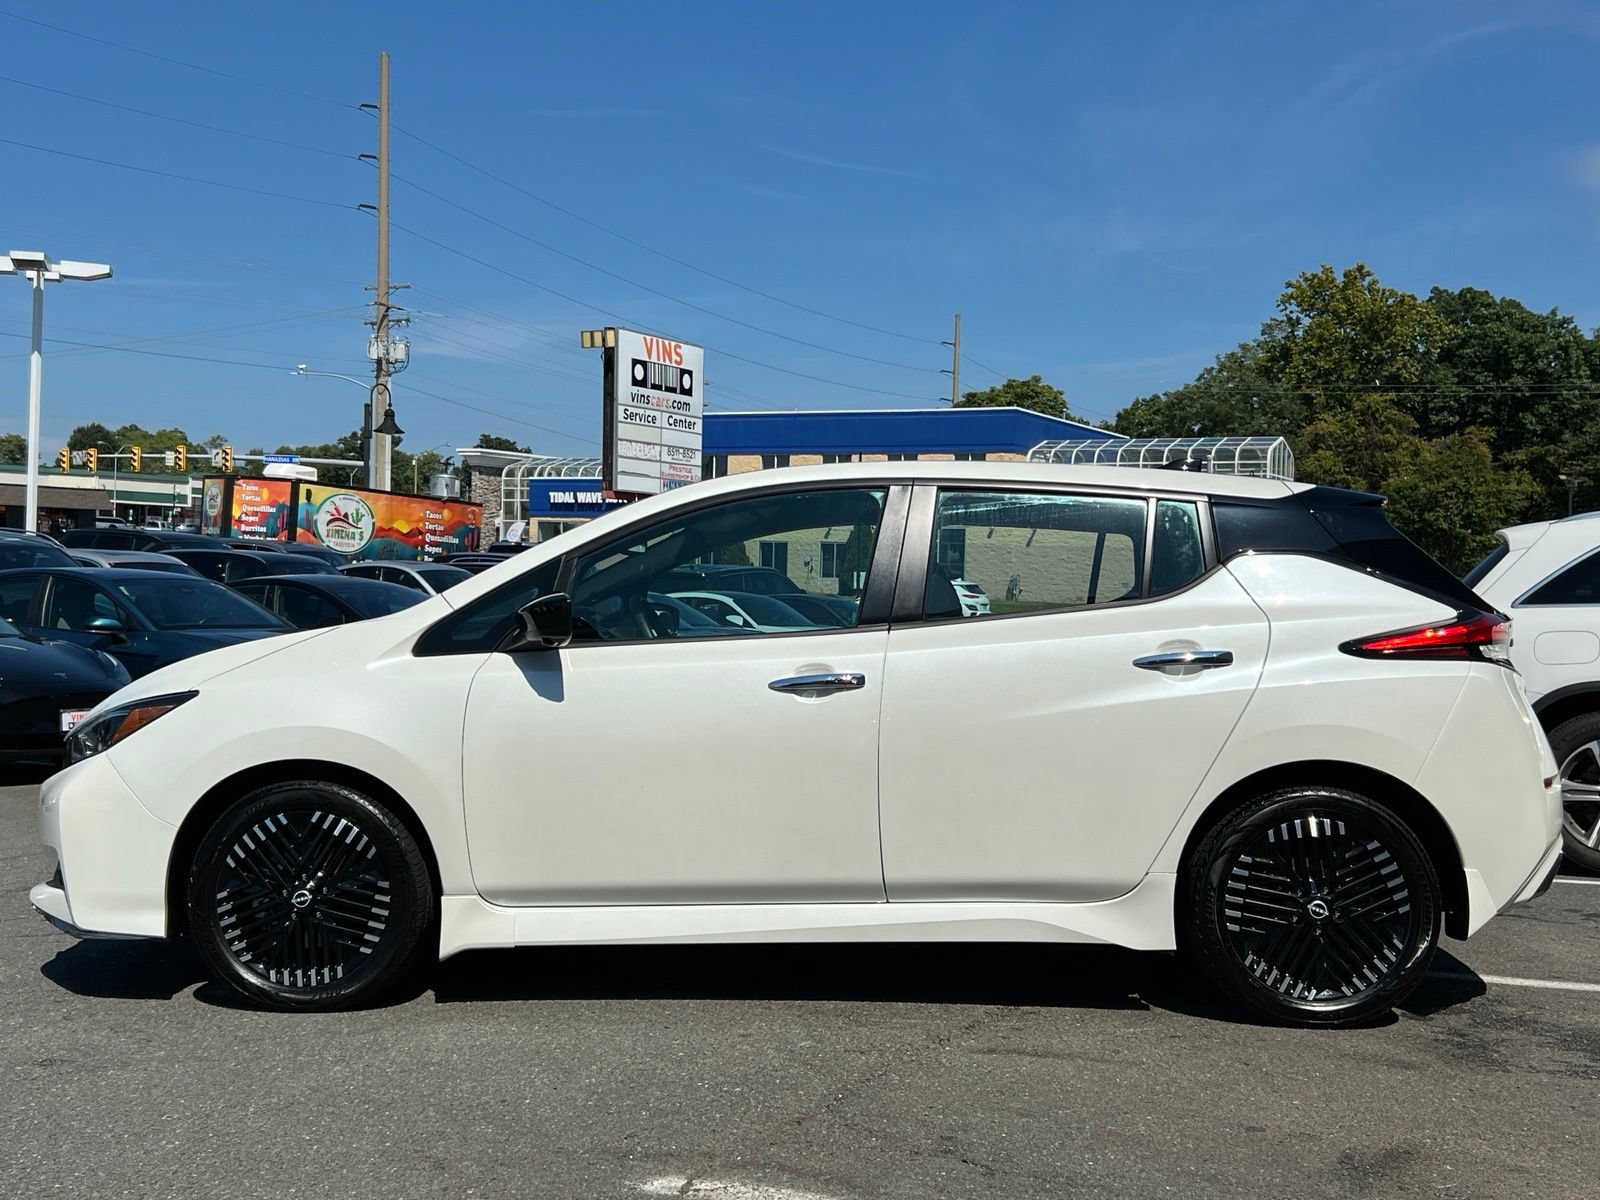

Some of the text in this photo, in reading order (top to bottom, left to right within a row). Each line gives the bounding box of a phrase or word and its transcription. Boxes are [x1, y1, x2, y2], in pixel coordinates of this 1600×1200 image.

[643, 336, 683, 366] VINS
[630, 389, 691, 412] vinscars.com
[623, 408, 697, 431] Service Center
[241, 483, 259, 491] Tacos
[241, 493, 260, 501] Tortas
[549, 491, 575, 503] TIDAL
[577, 491, 603, 503] WAVE
[242, 504, 276, 513] Quesadillas
[240, 513, 259, 522] Sopes
[425, 510, 442, 519] Tacos
[240, 525, 267, 533] Burritos
[425, 521, 444, 531] Tortas
[326, 528, 365, 542] XIMENA'S
[425, 533, 459, 544] Quesadillas
[424, 544, 442, 555] Sopes
